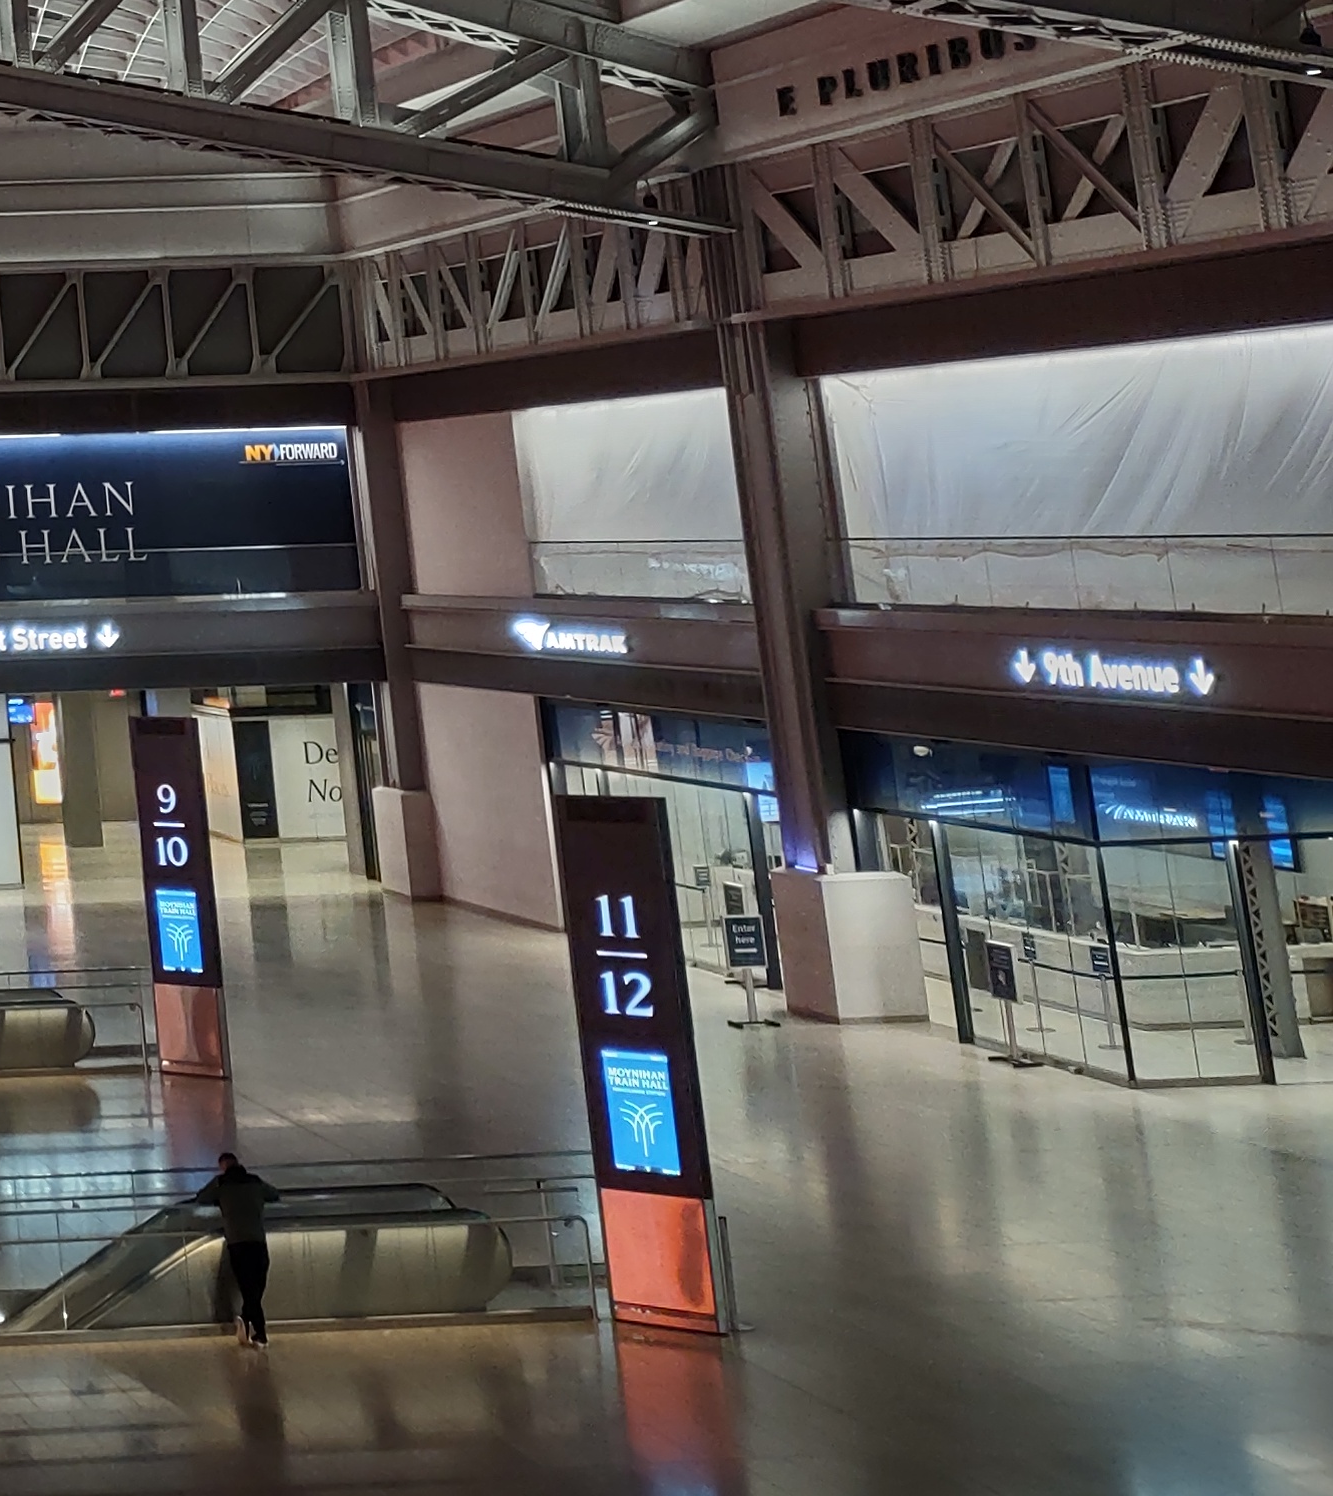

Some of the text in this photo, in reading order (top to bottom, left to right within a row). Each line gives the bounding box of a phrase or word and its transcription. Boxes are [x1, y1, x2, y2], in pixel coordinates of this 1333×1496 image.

[776, 86, 797, 117] E
[244, 442, 338, 461] NY FORWARD
[19, 526, 149, 565] HALL
[11, 627, 88, 651] Street
[546, 631, 628, 653] AMTRAK
[1043, 652, 1180, 693] 9th Avenue
[156, 784, 177, 814] 9
[155, 836, 188, 867] 10
[595, 894, 641, 938] 11
[600, 970, 654, 1018] 12
